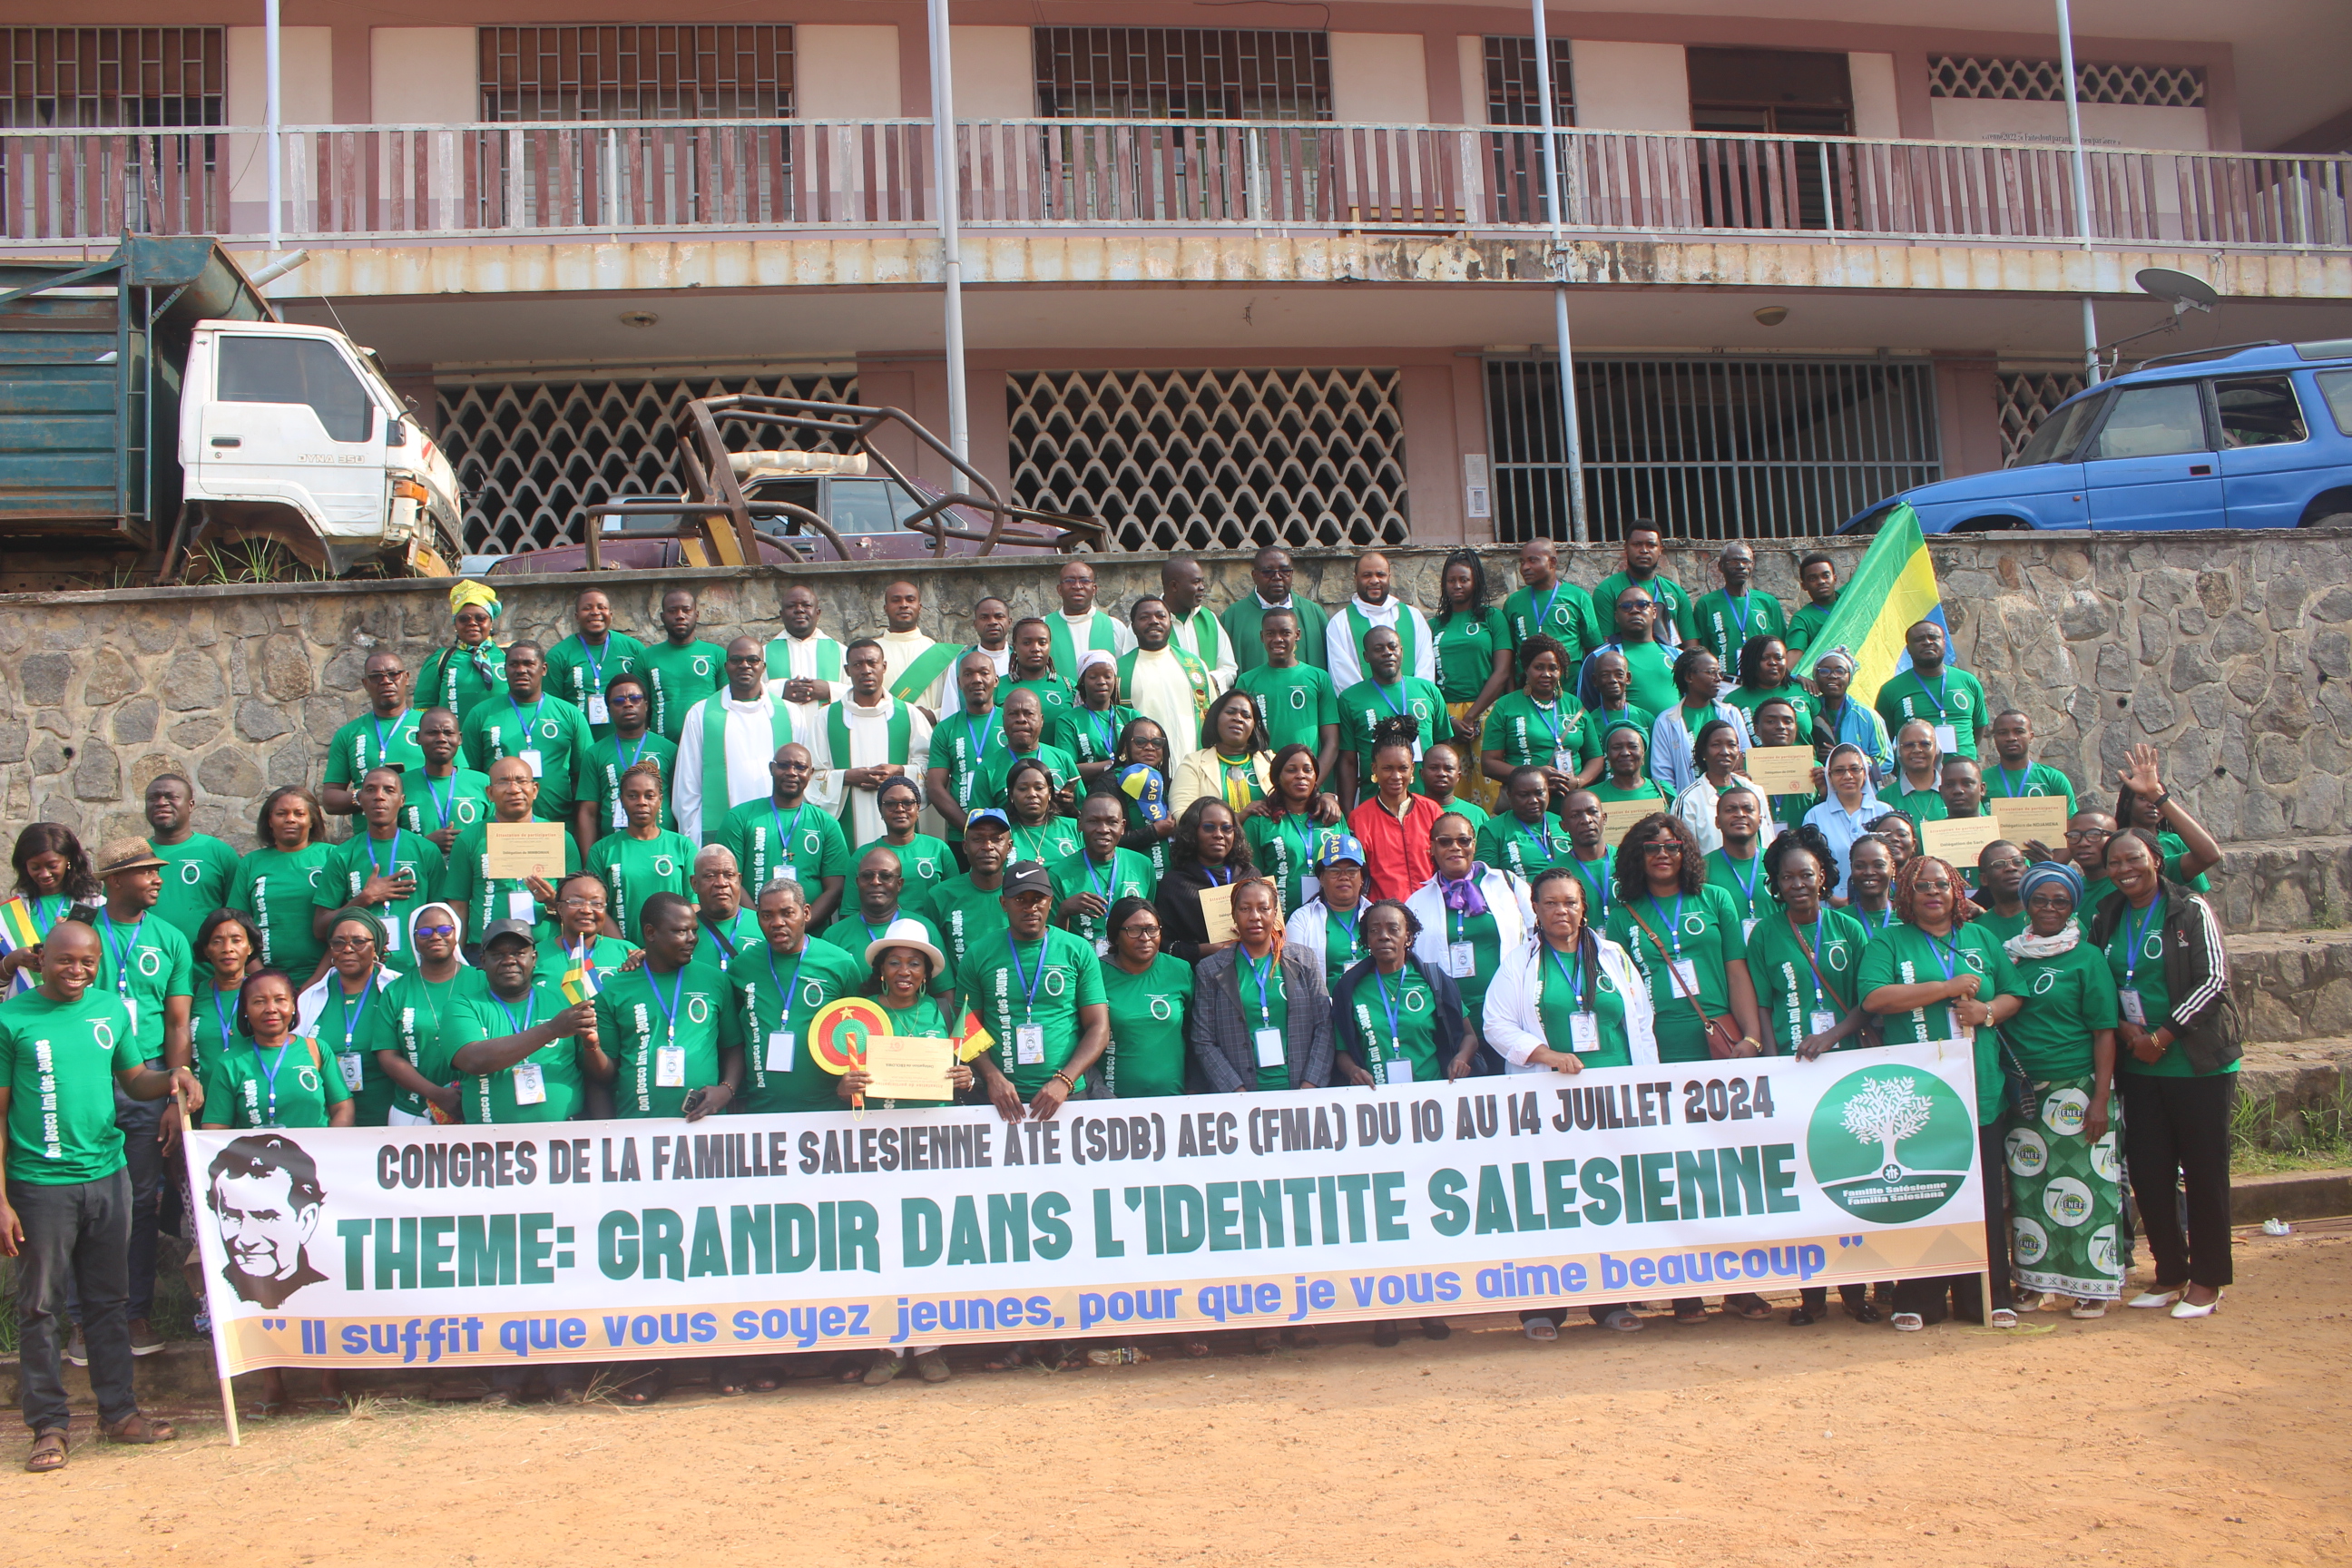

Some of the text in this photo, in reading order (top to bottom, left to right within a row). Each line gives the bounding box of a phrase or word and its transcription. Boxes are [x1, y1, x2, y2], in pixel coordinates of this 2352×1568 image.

[298, 454, 334, 464] DYNA
[956, 736, 967, 760] Jeunes
[958, 787, 968, 808] Bosco
[408, 806, 422, 833] Jeunes
[754, 827, 768, 852] Jeunes
[1271, 836, 1288, 861] Jeunes
[754, 853, 767, 868] des
[951, 909, 965, 955] des Jeunes
[995, 967, 1009, 998] Jeunes
[1781, 961, 1798, 991] Jeunes
[1899, 960, 1916, 985] eunes
[996, 998, 1011, 1014] des
[1786, 991, 1800, 1008] des
[402, 1007, 416, 1034] Jeunes
[633, 1003, 651, 1034] Jeunes
[749, 1012, 759, 1028] des
[1788, 1006, 1801, 1024] Ami
[405, 1036, 416, 1052] des
[1000, 1031, 1012, 1058] Bosco
[1355, 1003, 1386, 1085] osco Ami des Jeunes
[636, 1050, 648, 1066] Ami
[753, 1044, 762, 1072] Bosco
[1003, 1059, 1014, 1074] Don
[1104, 1054, 1115, 1081] Bosco
[636, 1066, 647, 1094] Bosco
[757, 1072, 765, 1088] Don
[35, 1039, 62, 1158] Don Bosco Ami des Jeunes
[244, 1079, 262, 1126] des Jeunes
[479, 1077, 493, 1123] Bosco Ami
[638, 1094, 651, 1112] Don
[2062, 1109, 2082, 1118] ENEF
[379, 1075, 1775, 1190] CONGRES DE LA FAMILLE SALESIENNE ATE (SDB) AEC (FMA) DU 10 AU 14 JUILLET 2024
[2021, 1151, 2040, 1160] ENEF
[1842, 1189, 1884, 1197] Famille
[1889, 1191, 1945, 1202] Salesiana
[2063, 1200, 2084, 1210] ENEF
[337, 1143, 1801, 1292] THEME: GRANDIR DANS L'IDENTITE SALESIENNE
[2019, 1241, 2038, 1250] ENEF
[301, 1243, 1827, 1364] Il suffit que vous soyez jeunes, pour que je vous aime beaucoup
